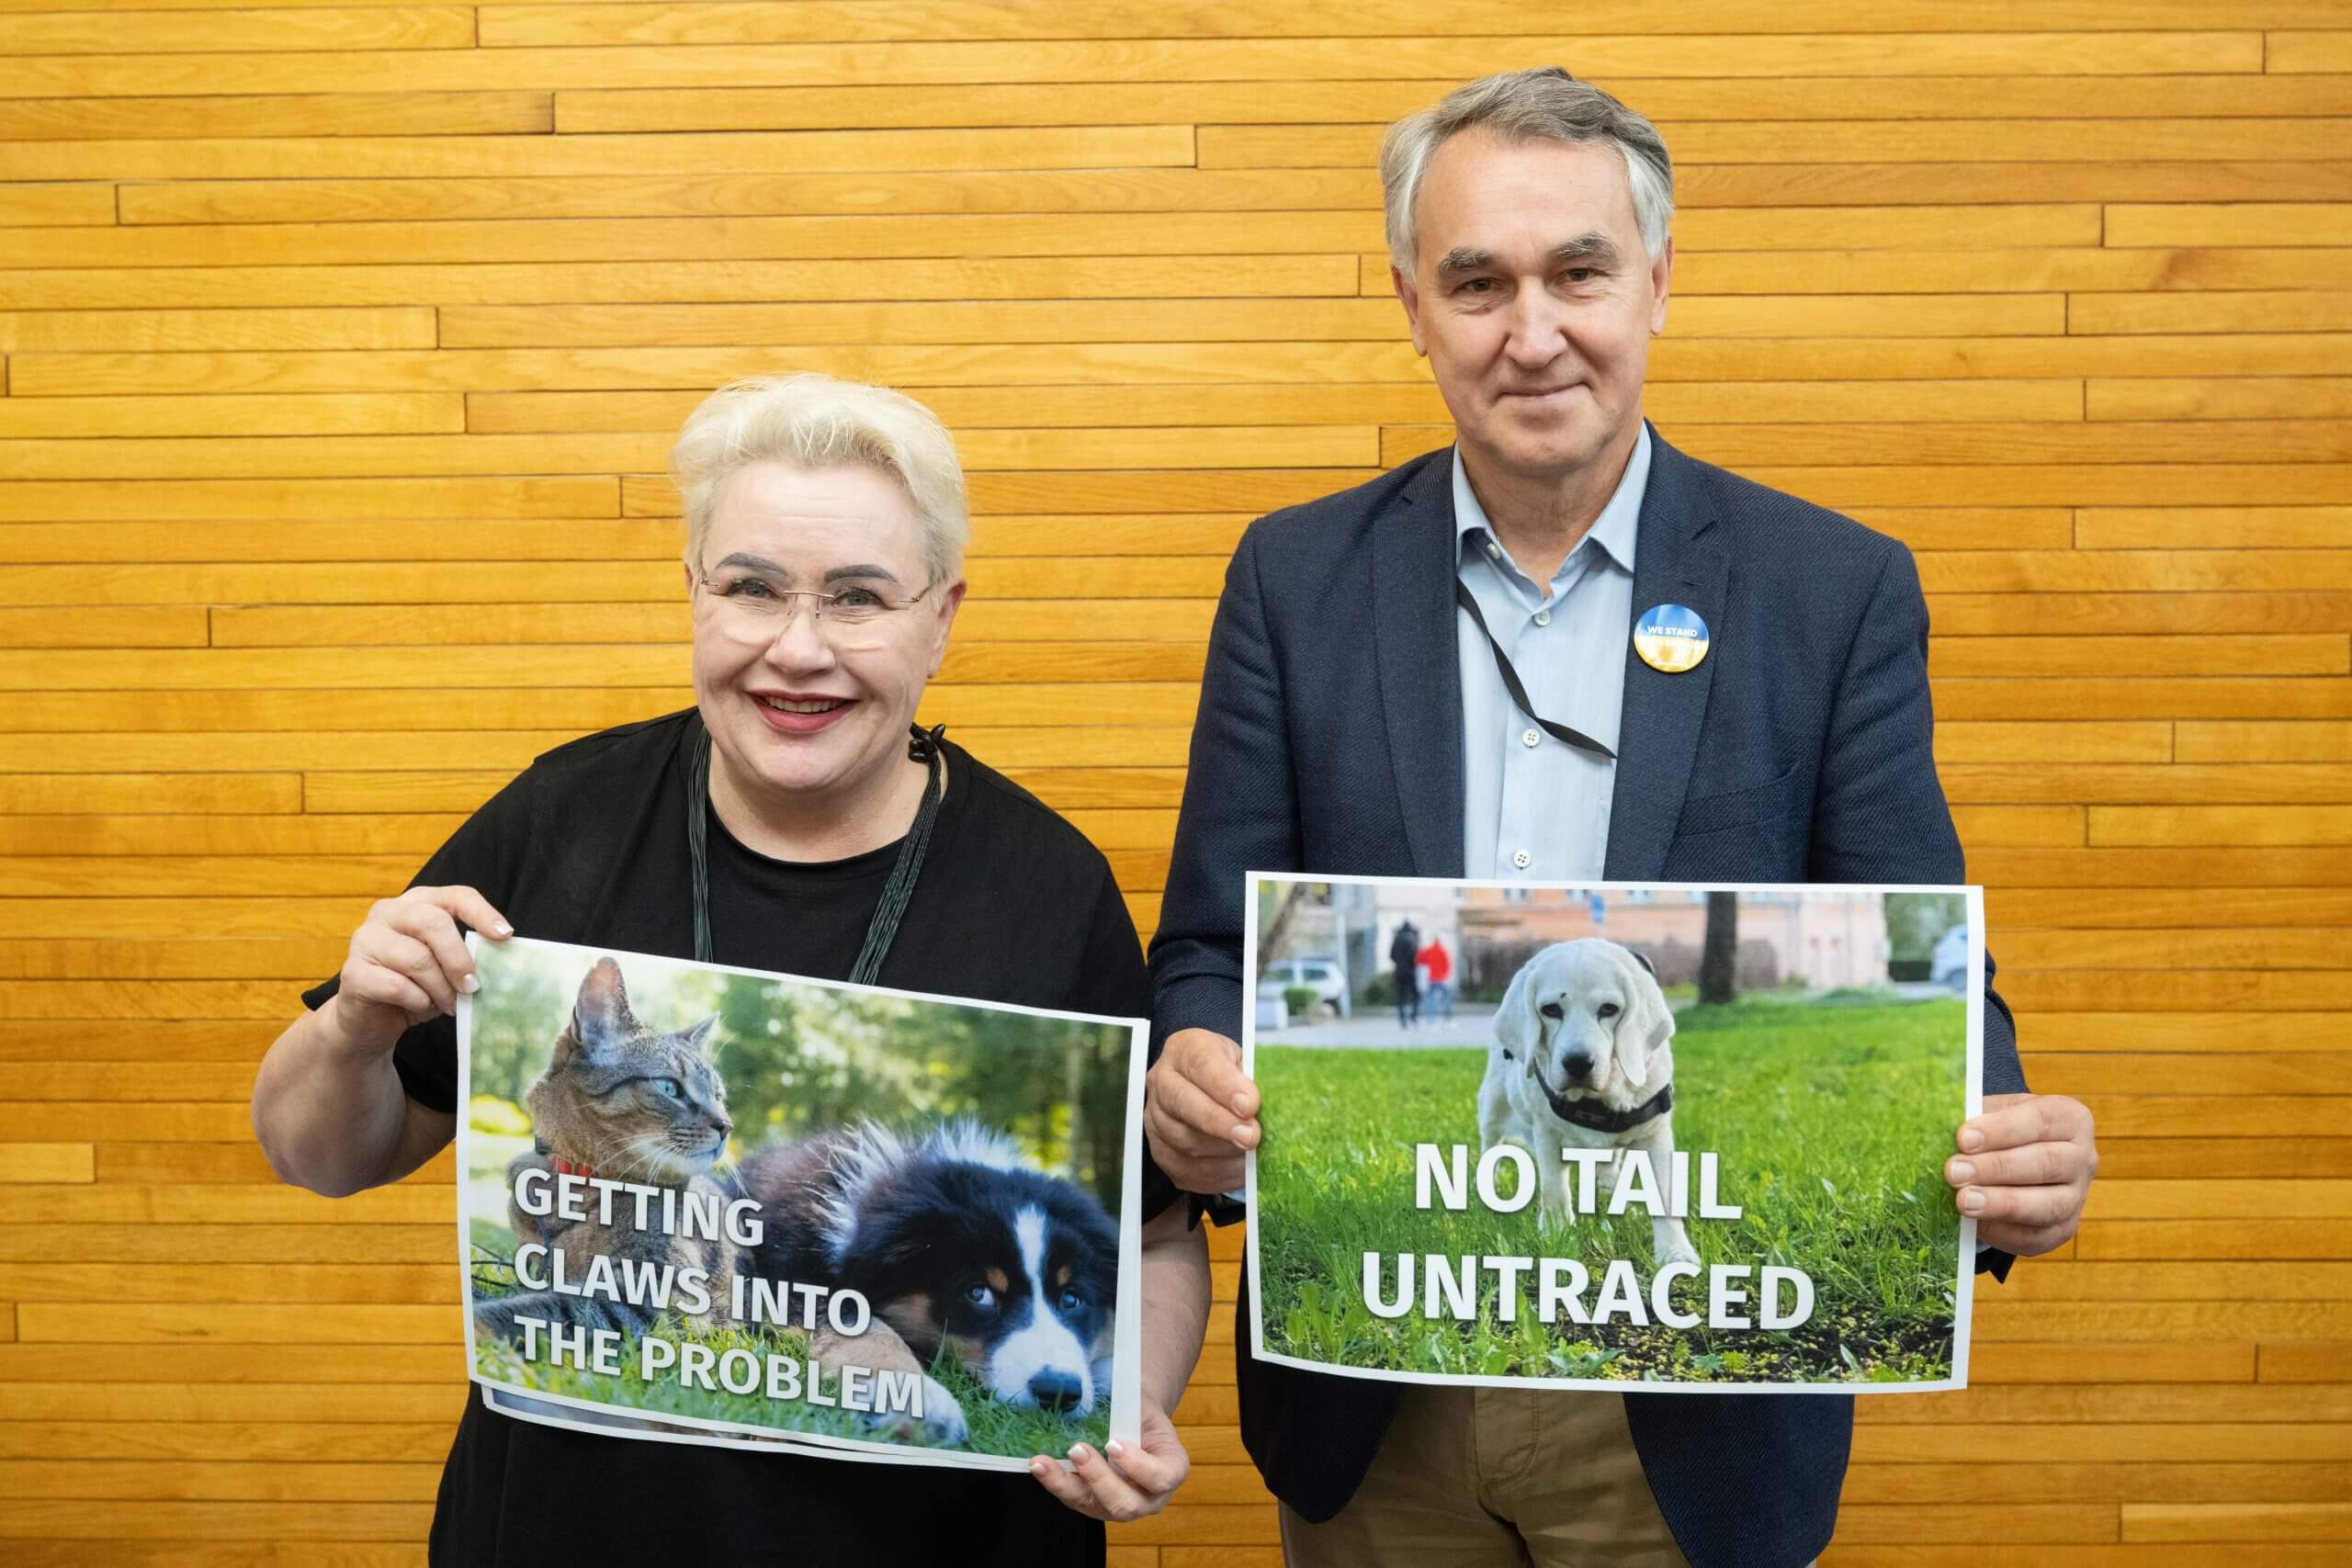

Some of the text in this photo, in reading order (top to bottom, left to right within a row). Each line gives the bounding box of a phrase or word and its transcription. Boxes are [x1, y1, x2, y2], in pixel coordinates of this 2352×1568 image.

[1647, 626, 1698, 637] WE STAND
[514, 1168, 763, 1246] GETTING
[1416, 1144, 1743, 1220] NO TAIL
[514, 1245, 871, 1337] CLAWS INTO
[1363, 1252, 1815, 1330] UNTRACED
[514, 1315, 922, 1417] THE PROBLEM
